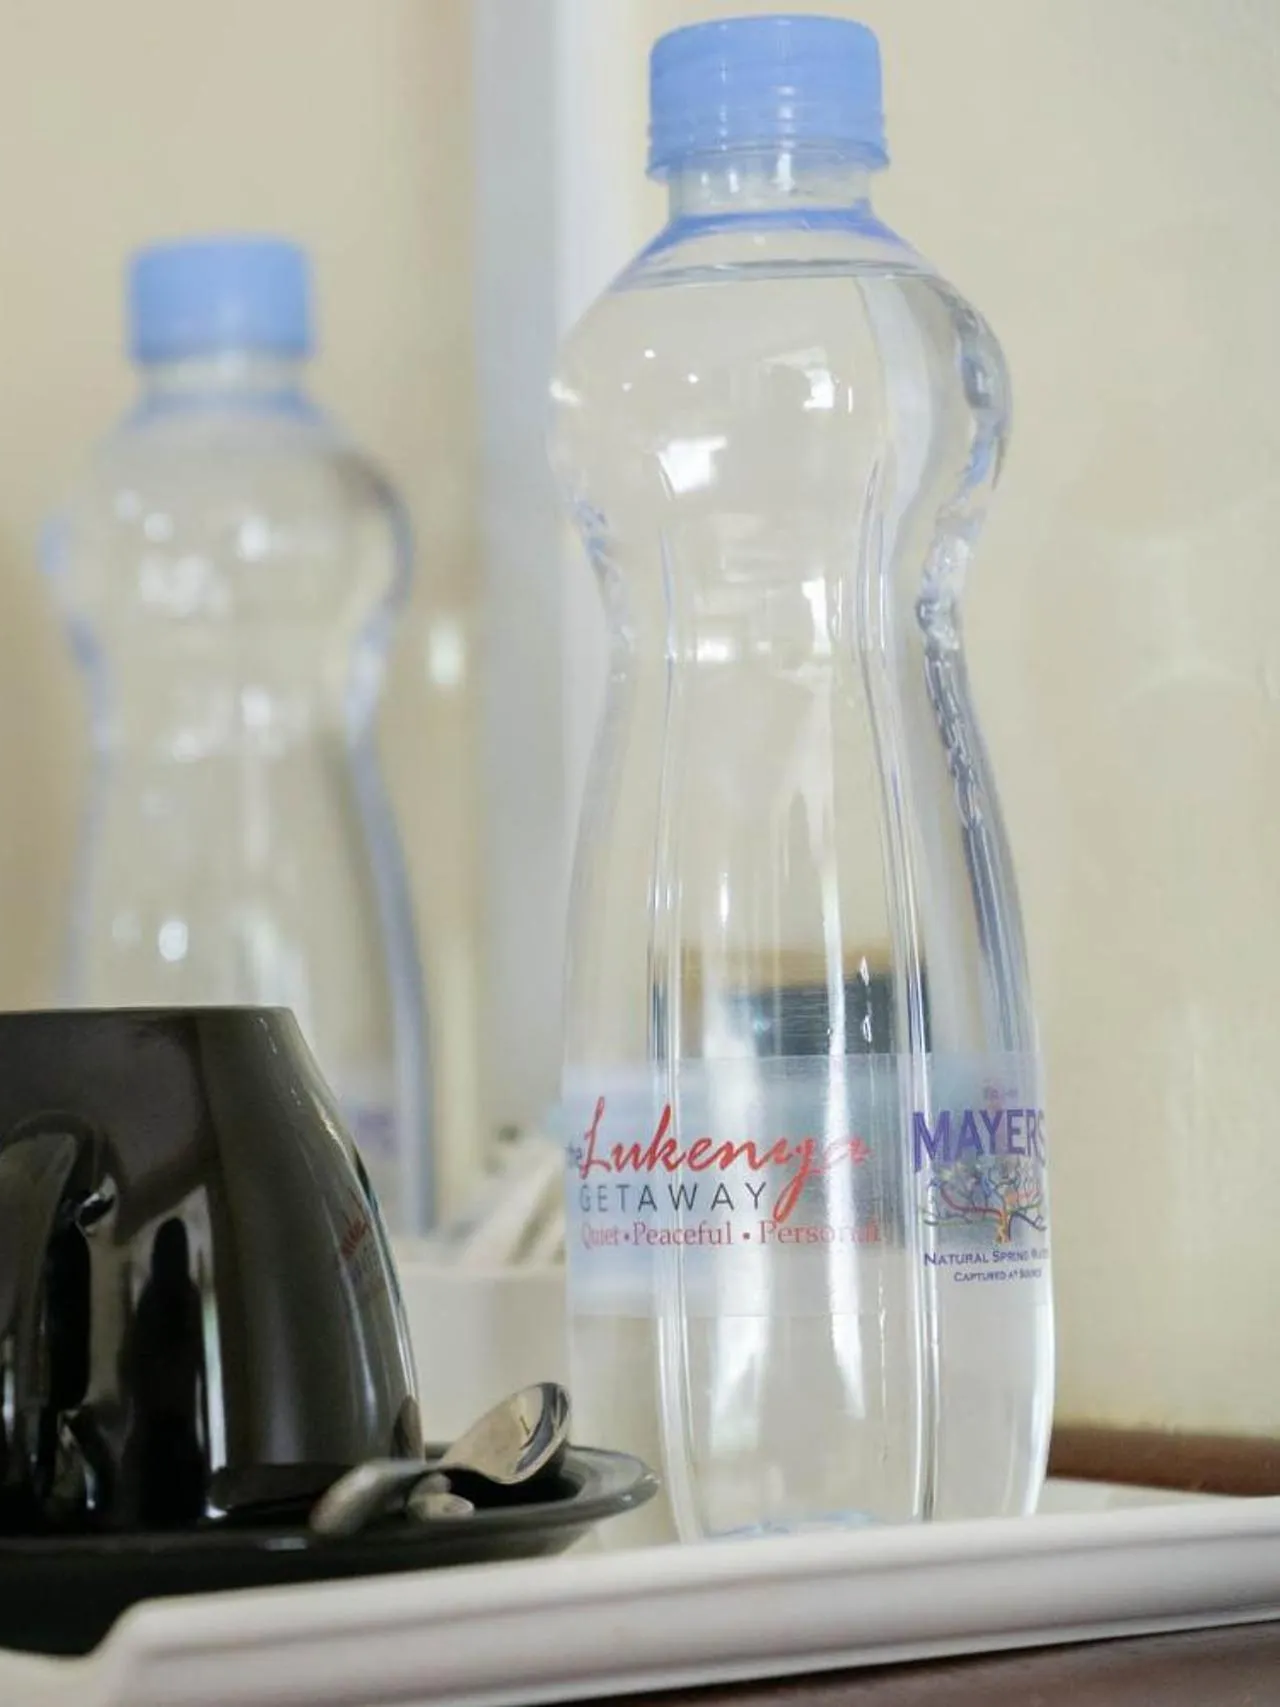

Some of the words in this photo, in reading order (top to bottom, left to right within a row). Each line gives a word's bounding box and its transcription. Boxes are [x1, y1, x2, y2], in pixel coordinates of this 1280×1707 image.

[579, 1182, 766, 1213] GETAWAY
[632, 1219, 733, 1246] Peaceful
[923, 1251, 989, 1266] NATURAL
